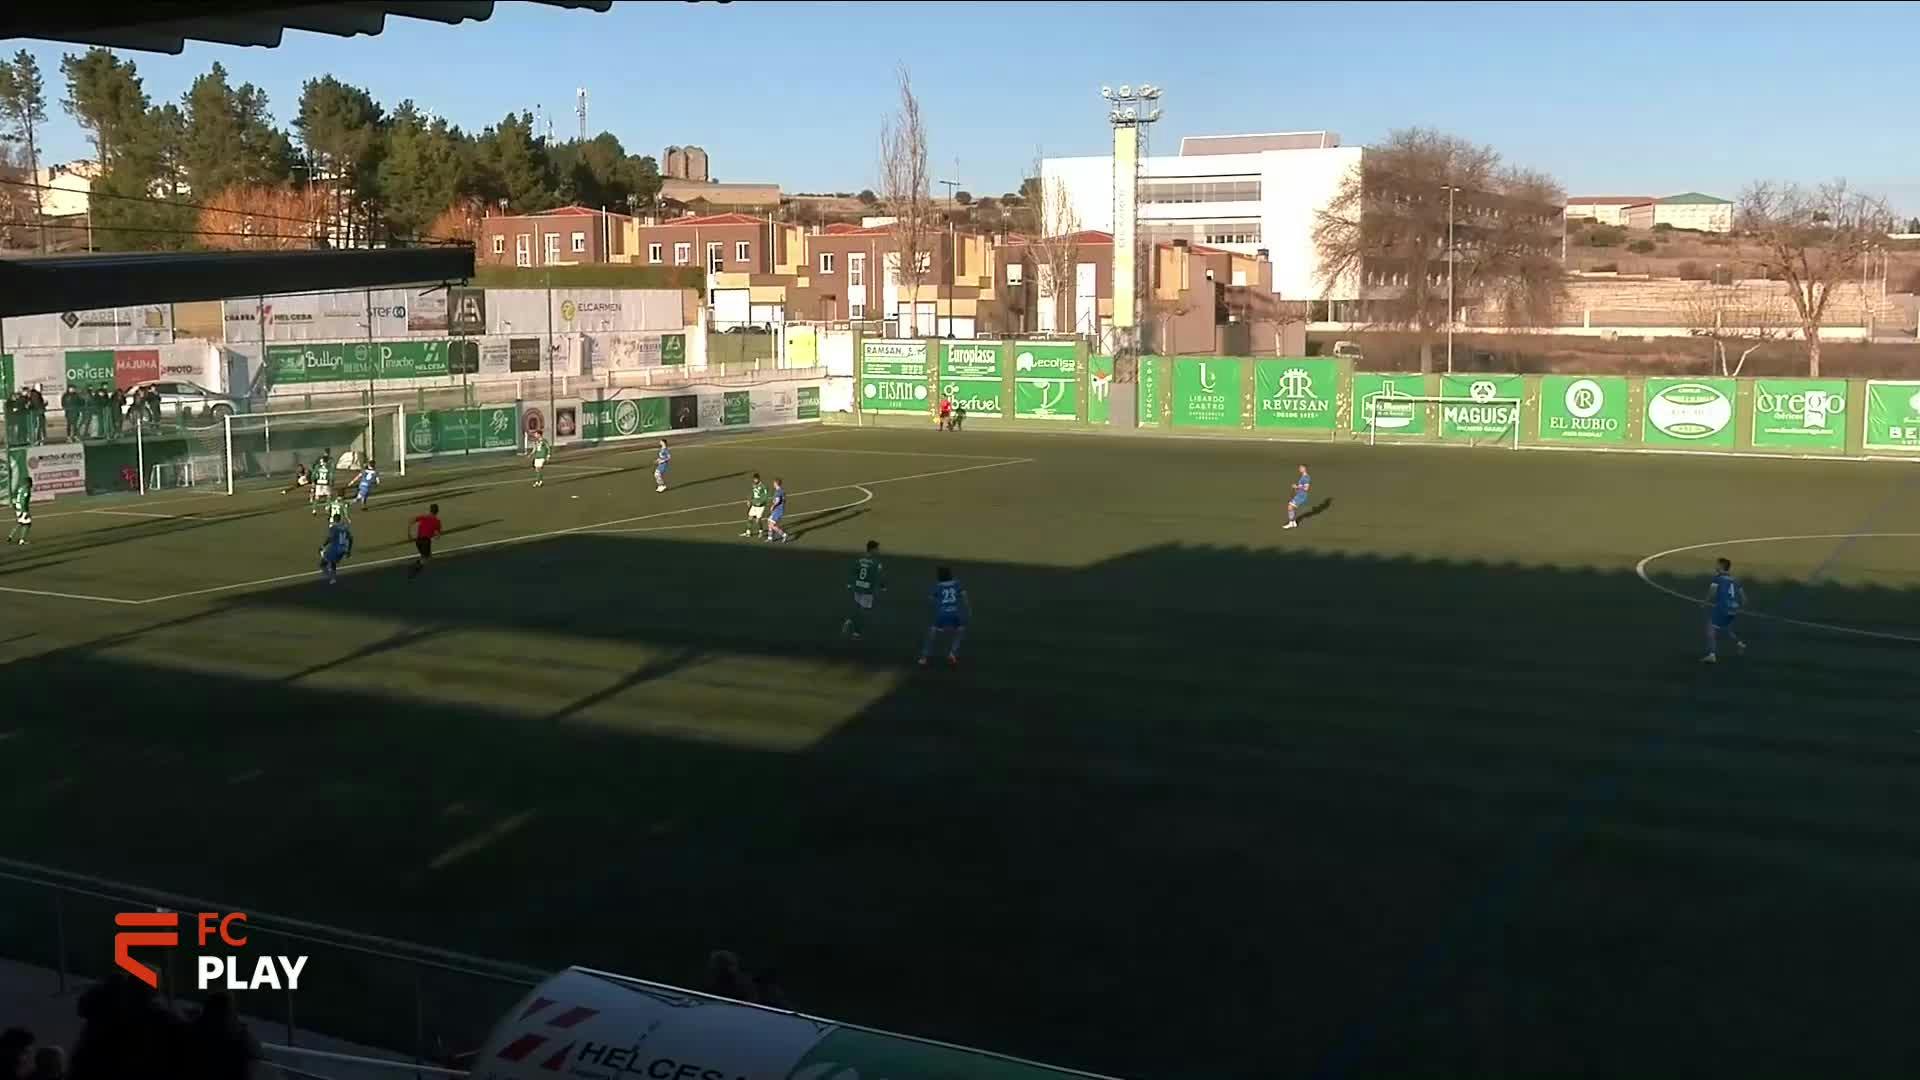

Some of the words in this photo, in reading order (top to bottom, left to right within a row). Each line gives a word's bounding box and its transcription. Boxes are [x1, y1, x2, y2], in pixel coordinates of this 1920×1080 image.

[67, 367, 114, 380] ORIGEN
[1189, 402, 1225, 411] CASTRO
[1263, 400, 1329, 412] REVISAN
[1444, 407, 1519, 425] MAGUISA
[1550, 417, 1568, 429] EL
[1571, 418, 1618, 431] RUBIO
[942, 588, 957, 603] 23
[577, 1041, 746, 1080] HELCES
